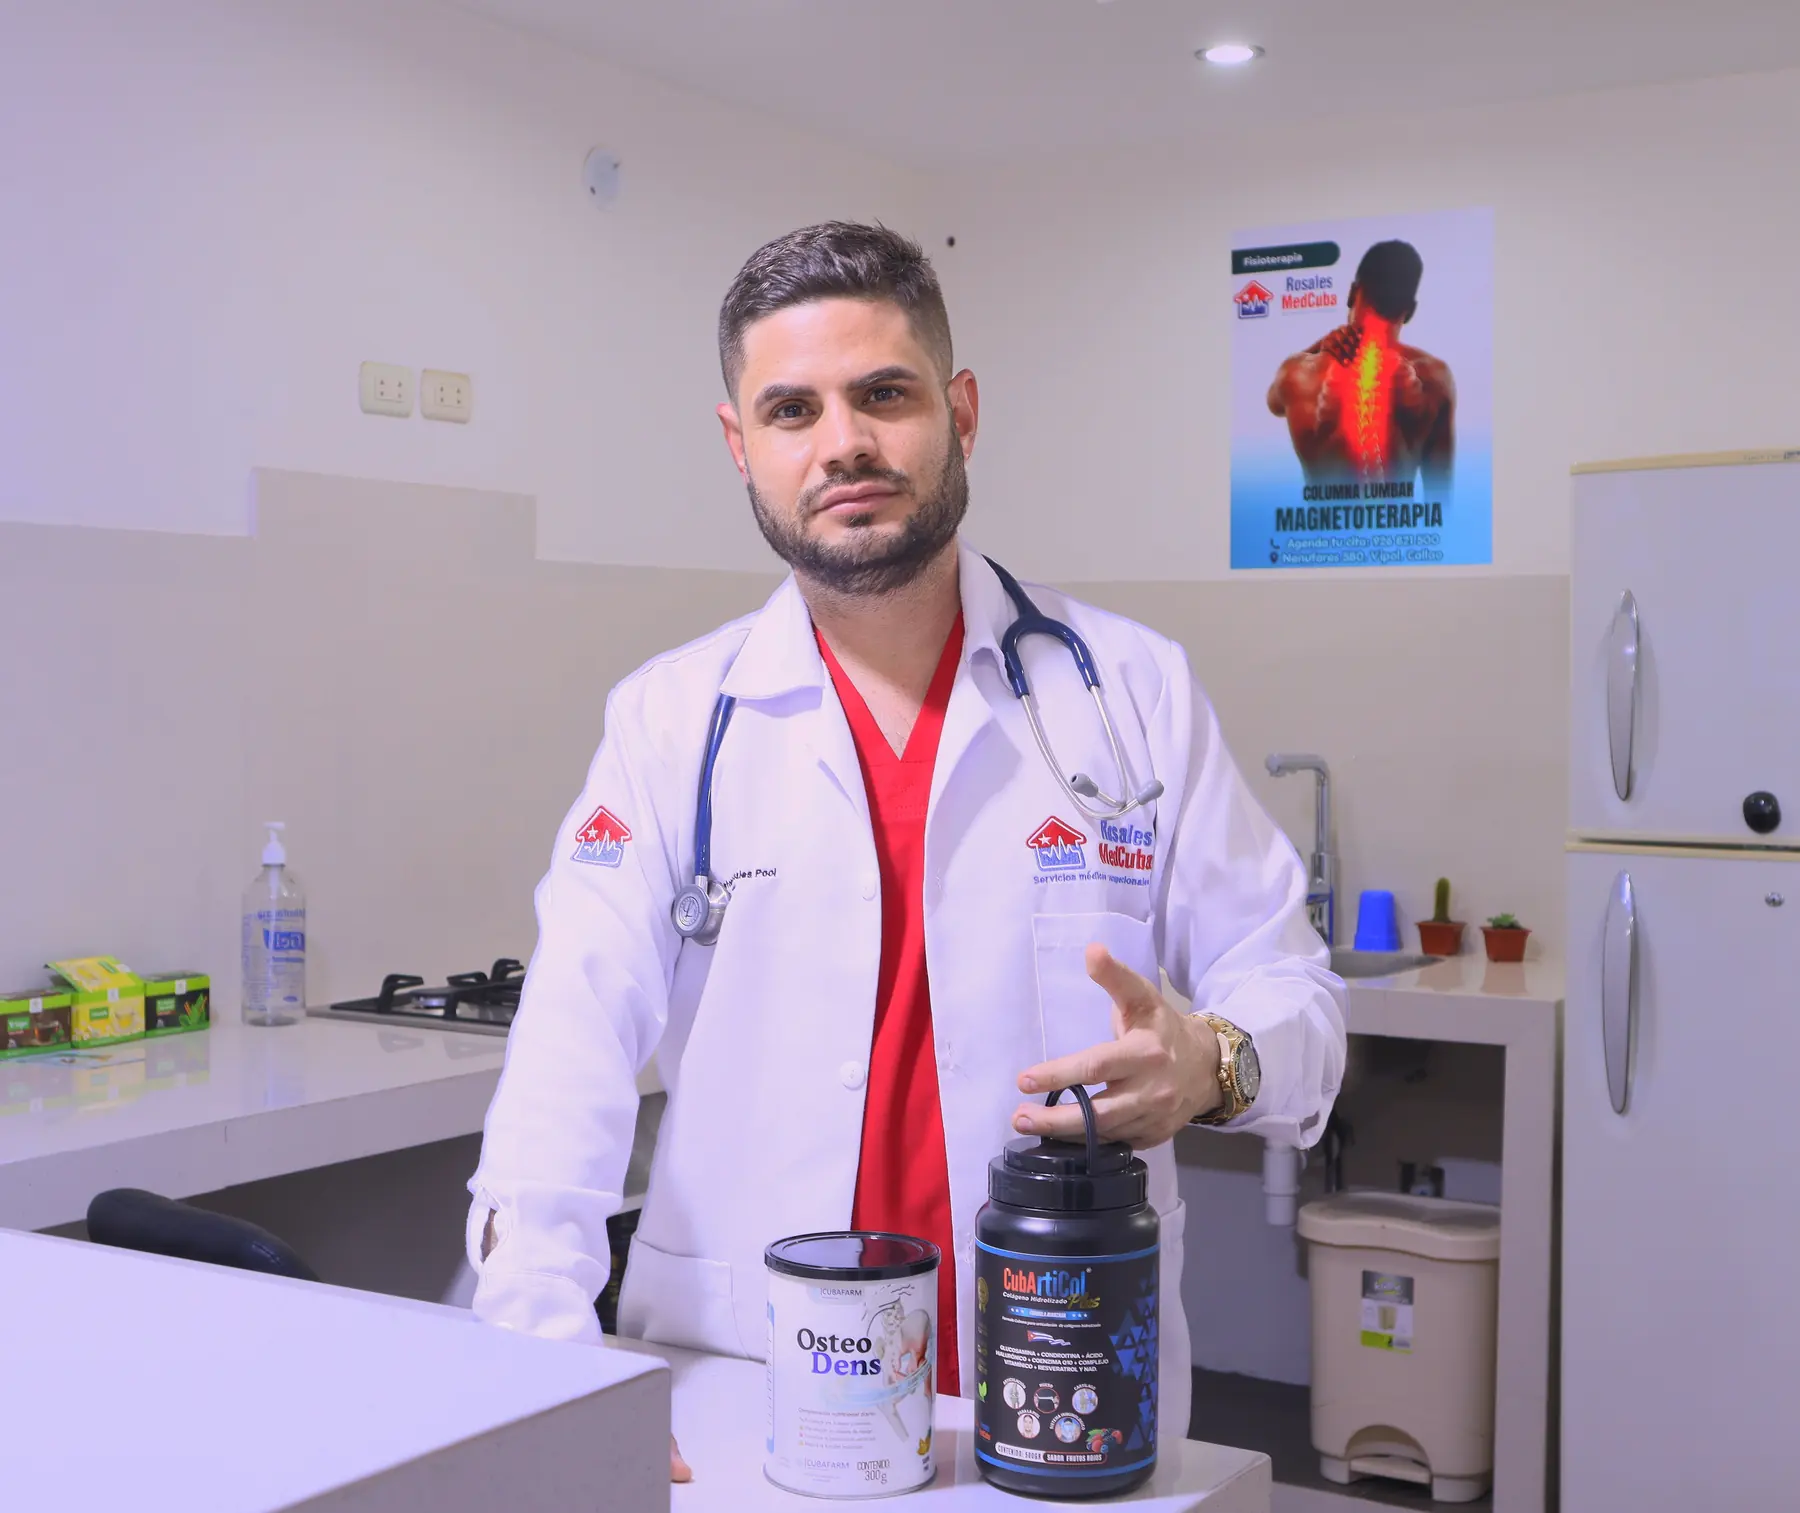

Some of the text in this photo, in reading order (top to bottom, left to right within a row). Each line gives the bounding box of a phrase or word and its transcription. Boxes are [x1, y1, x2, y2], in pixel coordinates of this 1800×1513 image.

[1243, 253, 1303, 267] Fisioterapia
[1286, 275, 1333, 291] Rosales
[1282, 291, 1337, 309] MedCuba
[1303, 482, 1414, 501] COLUMNA LUMBAR
[1275, 502, 1442, 532] MAGNETOTERAPIA
[1287, 537, 1329, 550] Agenda
[1331, 537, 1344, 548] tu
[1406, 548, 1443, 561] Callao
[1100, 820, 1153, 847] Rosales
[1098, 843, 1153, 870] MedCuba
[755, 867, 777, 878] Pool
[1033, 874, 1077, 884] Servicios
[1030, 1296, 1068, 1304] Hidrolizado
[1068, 1292, 1101, 1309] Plus
[797, 1328, 872, 1353] Osteo
[1000, 1344, 1036, 1357] GLUCOSAMINA
[811, 1351, 881, 1375] Dens
[1038, 1365, 1078, 1373] RESVERATROL
[1066, 1454, 1086, 1462] FRUTOS
